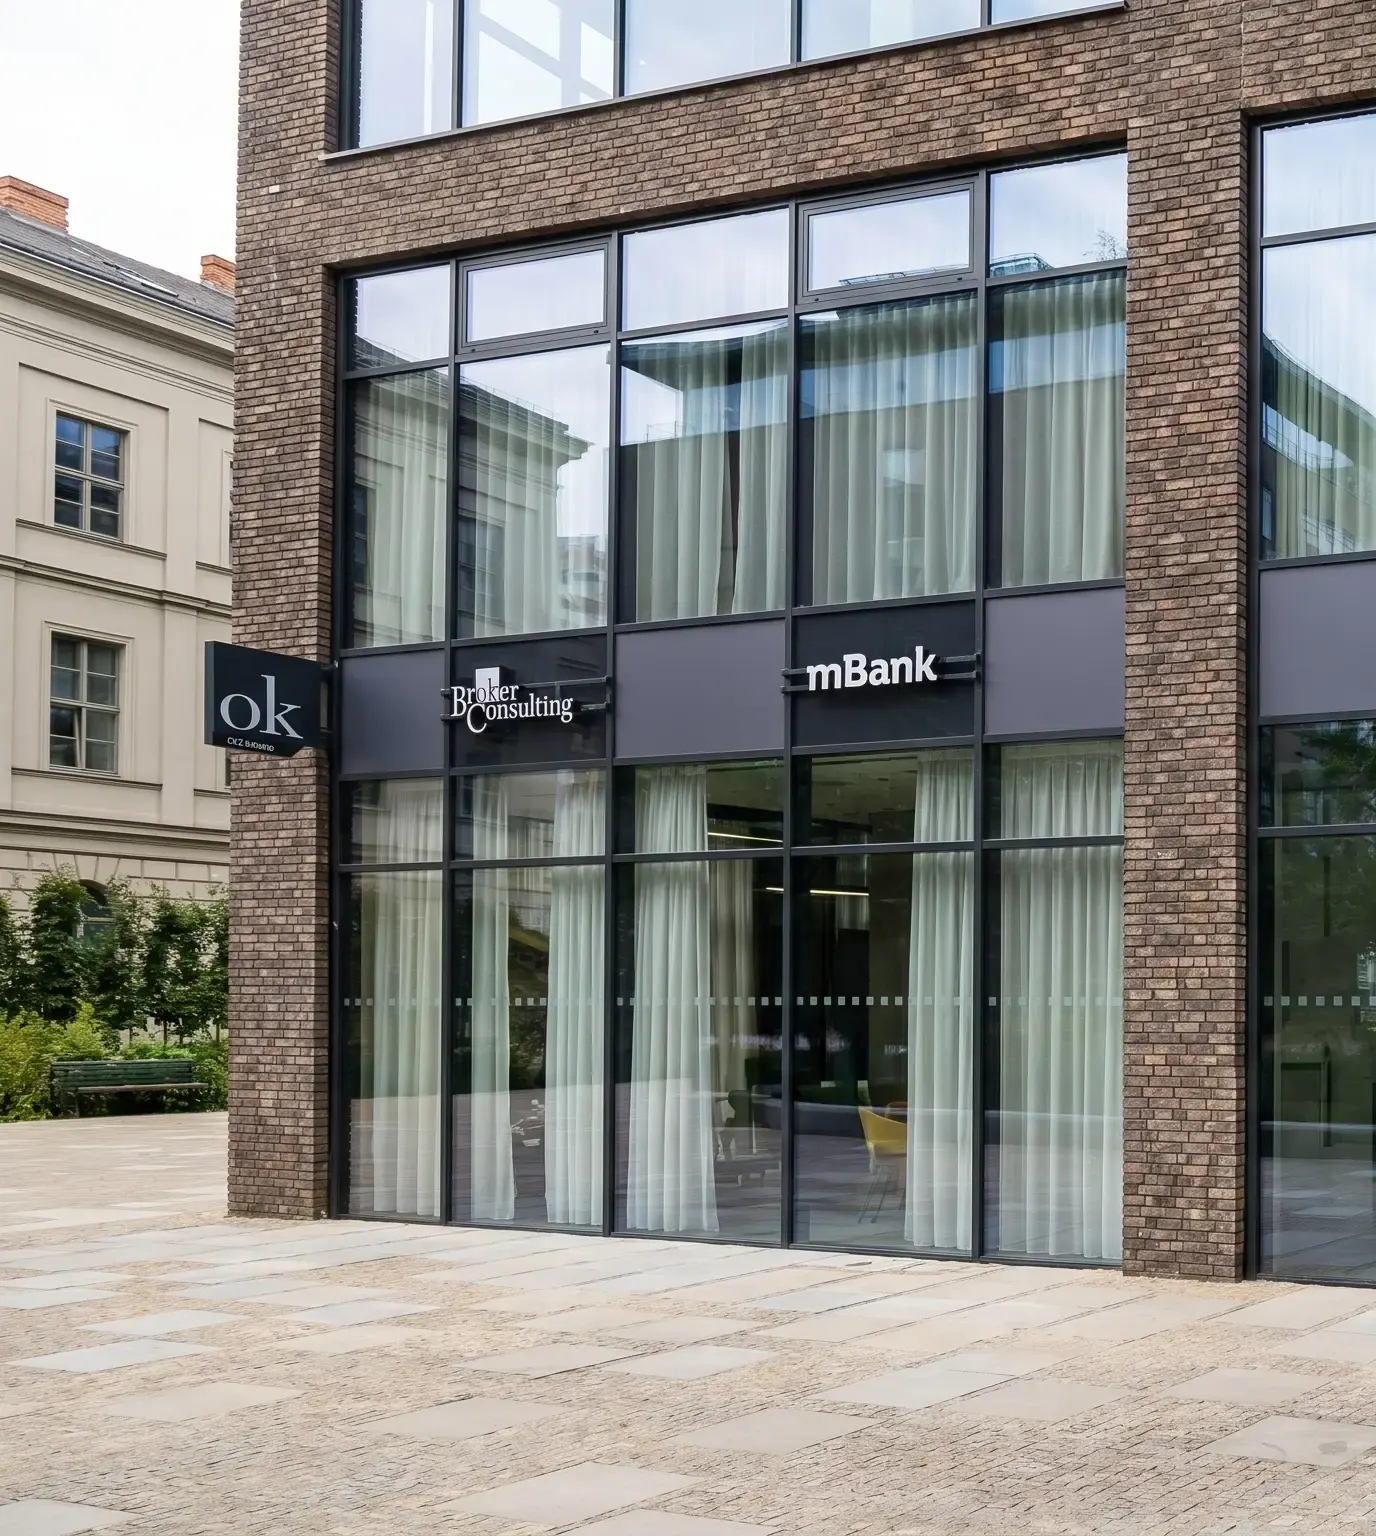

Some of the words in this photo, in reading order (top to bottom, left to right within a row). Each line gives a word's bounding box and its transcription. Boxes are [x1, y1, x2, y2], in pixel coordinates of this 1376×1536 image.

[806, 645, 938, 691] mBank
[220, 674, 304, 739] ok
[450, 677, 519, 717] Broker
[466, 693, 574, 734] Consulting
